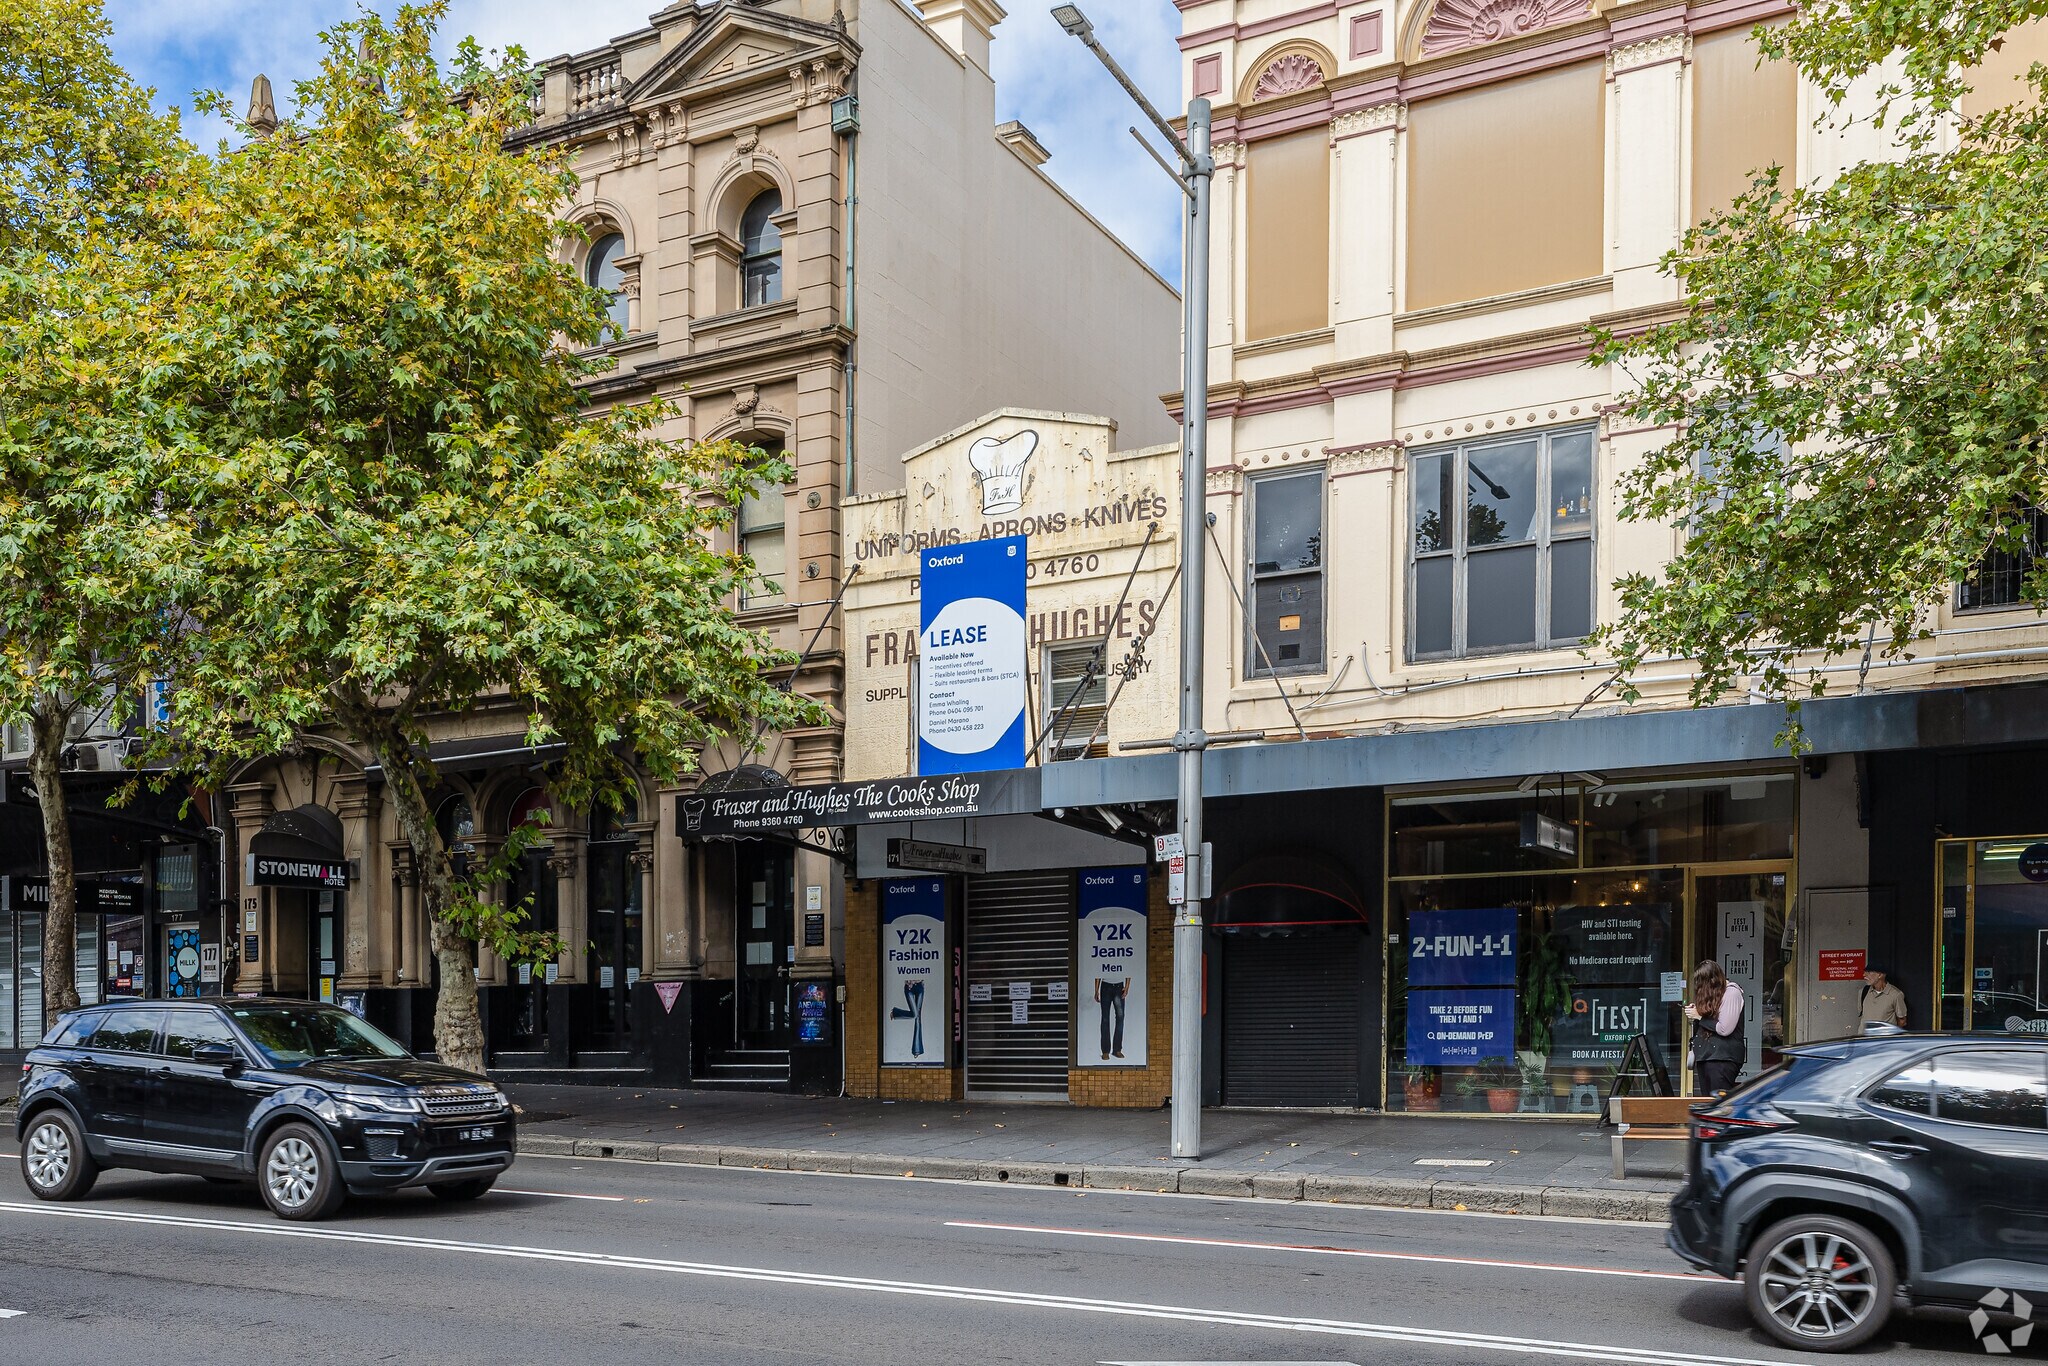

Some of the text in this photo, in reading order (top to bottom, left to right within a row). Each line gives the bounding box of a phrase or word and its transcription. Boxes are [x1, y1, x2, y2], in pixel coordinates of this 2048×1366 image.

[855, 496, 1167, 561] UNIFORMS APRONS KNIVES
[928, 554, 964, 568] Oxford
[1045, 554, 1099, 577] 4760
[866, 600, 1156, 668] FRA HUGHES
[930, 625, 987, 648] LEASE
[930, 654, 959, 662] Available
[949, 677, 980, 686] restaurants
[1000, 672, 1019, 680] (STCA)
[866, 686, 908, 702] SUPPL
[712, 776, 980, 817] Fraser and Hughes The Cooks Shop
[868, 803, 979, 820] www.cooksshop.com.au
[733, 815, 803, 829] Phone 9360 4760
[888, 854, 899, 863] 171
[1171, 858, 1183, 866] BUS
[258, 860, 345, 879] STONEWALL
[1085, 876, 1114, 885] Oxford
[889, 885, 916, 894] Oxford
[244, 898, 257, 910] 175
[171, 914, 183, 922] 177
[1581, 919, 1641, 929] HIV and STI testing
[896, 928, 931, 945] Y2K
[1092, 923, 1133, 940] Y2K
[1588, 932, 1634, 941] available here.
[1091, 946, 1133, 958] Jeans
[1412, 934, 1512, 958] 2-FUN-1-1
[203, 948, 217, 960] 177
[889, 948, 939, 962] Fashion
[1570, 954, 1653, 965] No Medicare card required.
[897, 966, 931, 974] Women
[1102, 964, 1123, 972] Men
[1429, 1006, 1445, 1014] TAKE
[1572, 1050, 1590, 1058] BOOK
